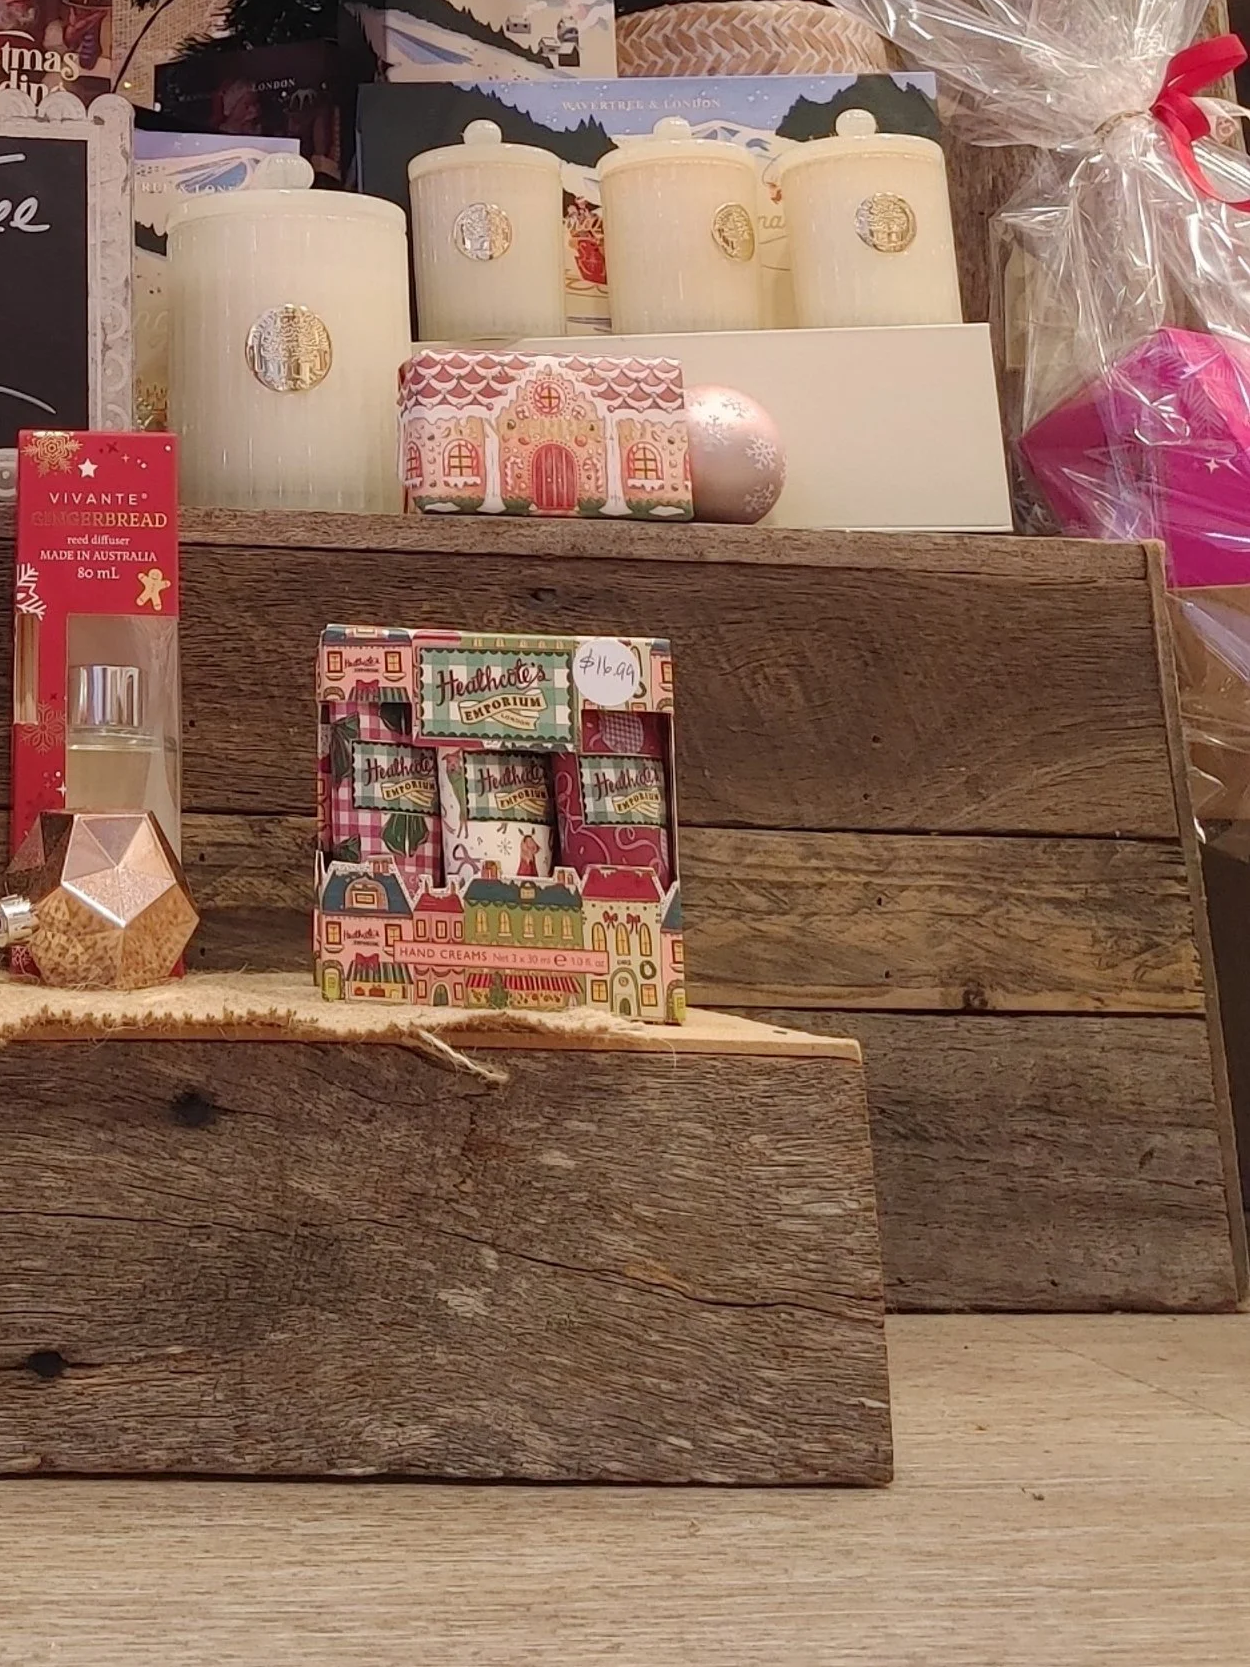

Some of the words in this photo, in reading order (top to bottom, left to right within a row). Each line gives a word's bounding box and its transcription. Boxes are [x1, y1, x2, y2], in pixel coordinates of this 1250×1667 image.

[251, 78, 296, 93] LONDON
[663, 97, 721, 110] LONDON
[31, 511, 168, 529] GINGERBREAD
[67, 534, 89, 546] reed
[91, 533, 131, 547] diffuser
[40, 550, 73, 562] MADE
[76, 550, 90, 562] IN
[93, 550, 158, 563] AUSTRALIA
[77, 566, 94, 580] 80
[97, 566, 120, 580] mL
[578, 649, 636, 685] $16.99
[435, 658, 551, 707] Heathcote's
[463, 695, 543, 722] EMPORIUM
[384, 780, 436, 800] EMPORIUM
[500, 790, 547, 809] EMPORIUM
[616, 791, 660, 813] EMPORIUM
[400, 947, 435, 959] HAND
[440, 949, 488, 961] CREAMS
[493, 953, 509, 963] Net
[512, 953, 518, 964] 3
[528, 954, 539, 965] 30
